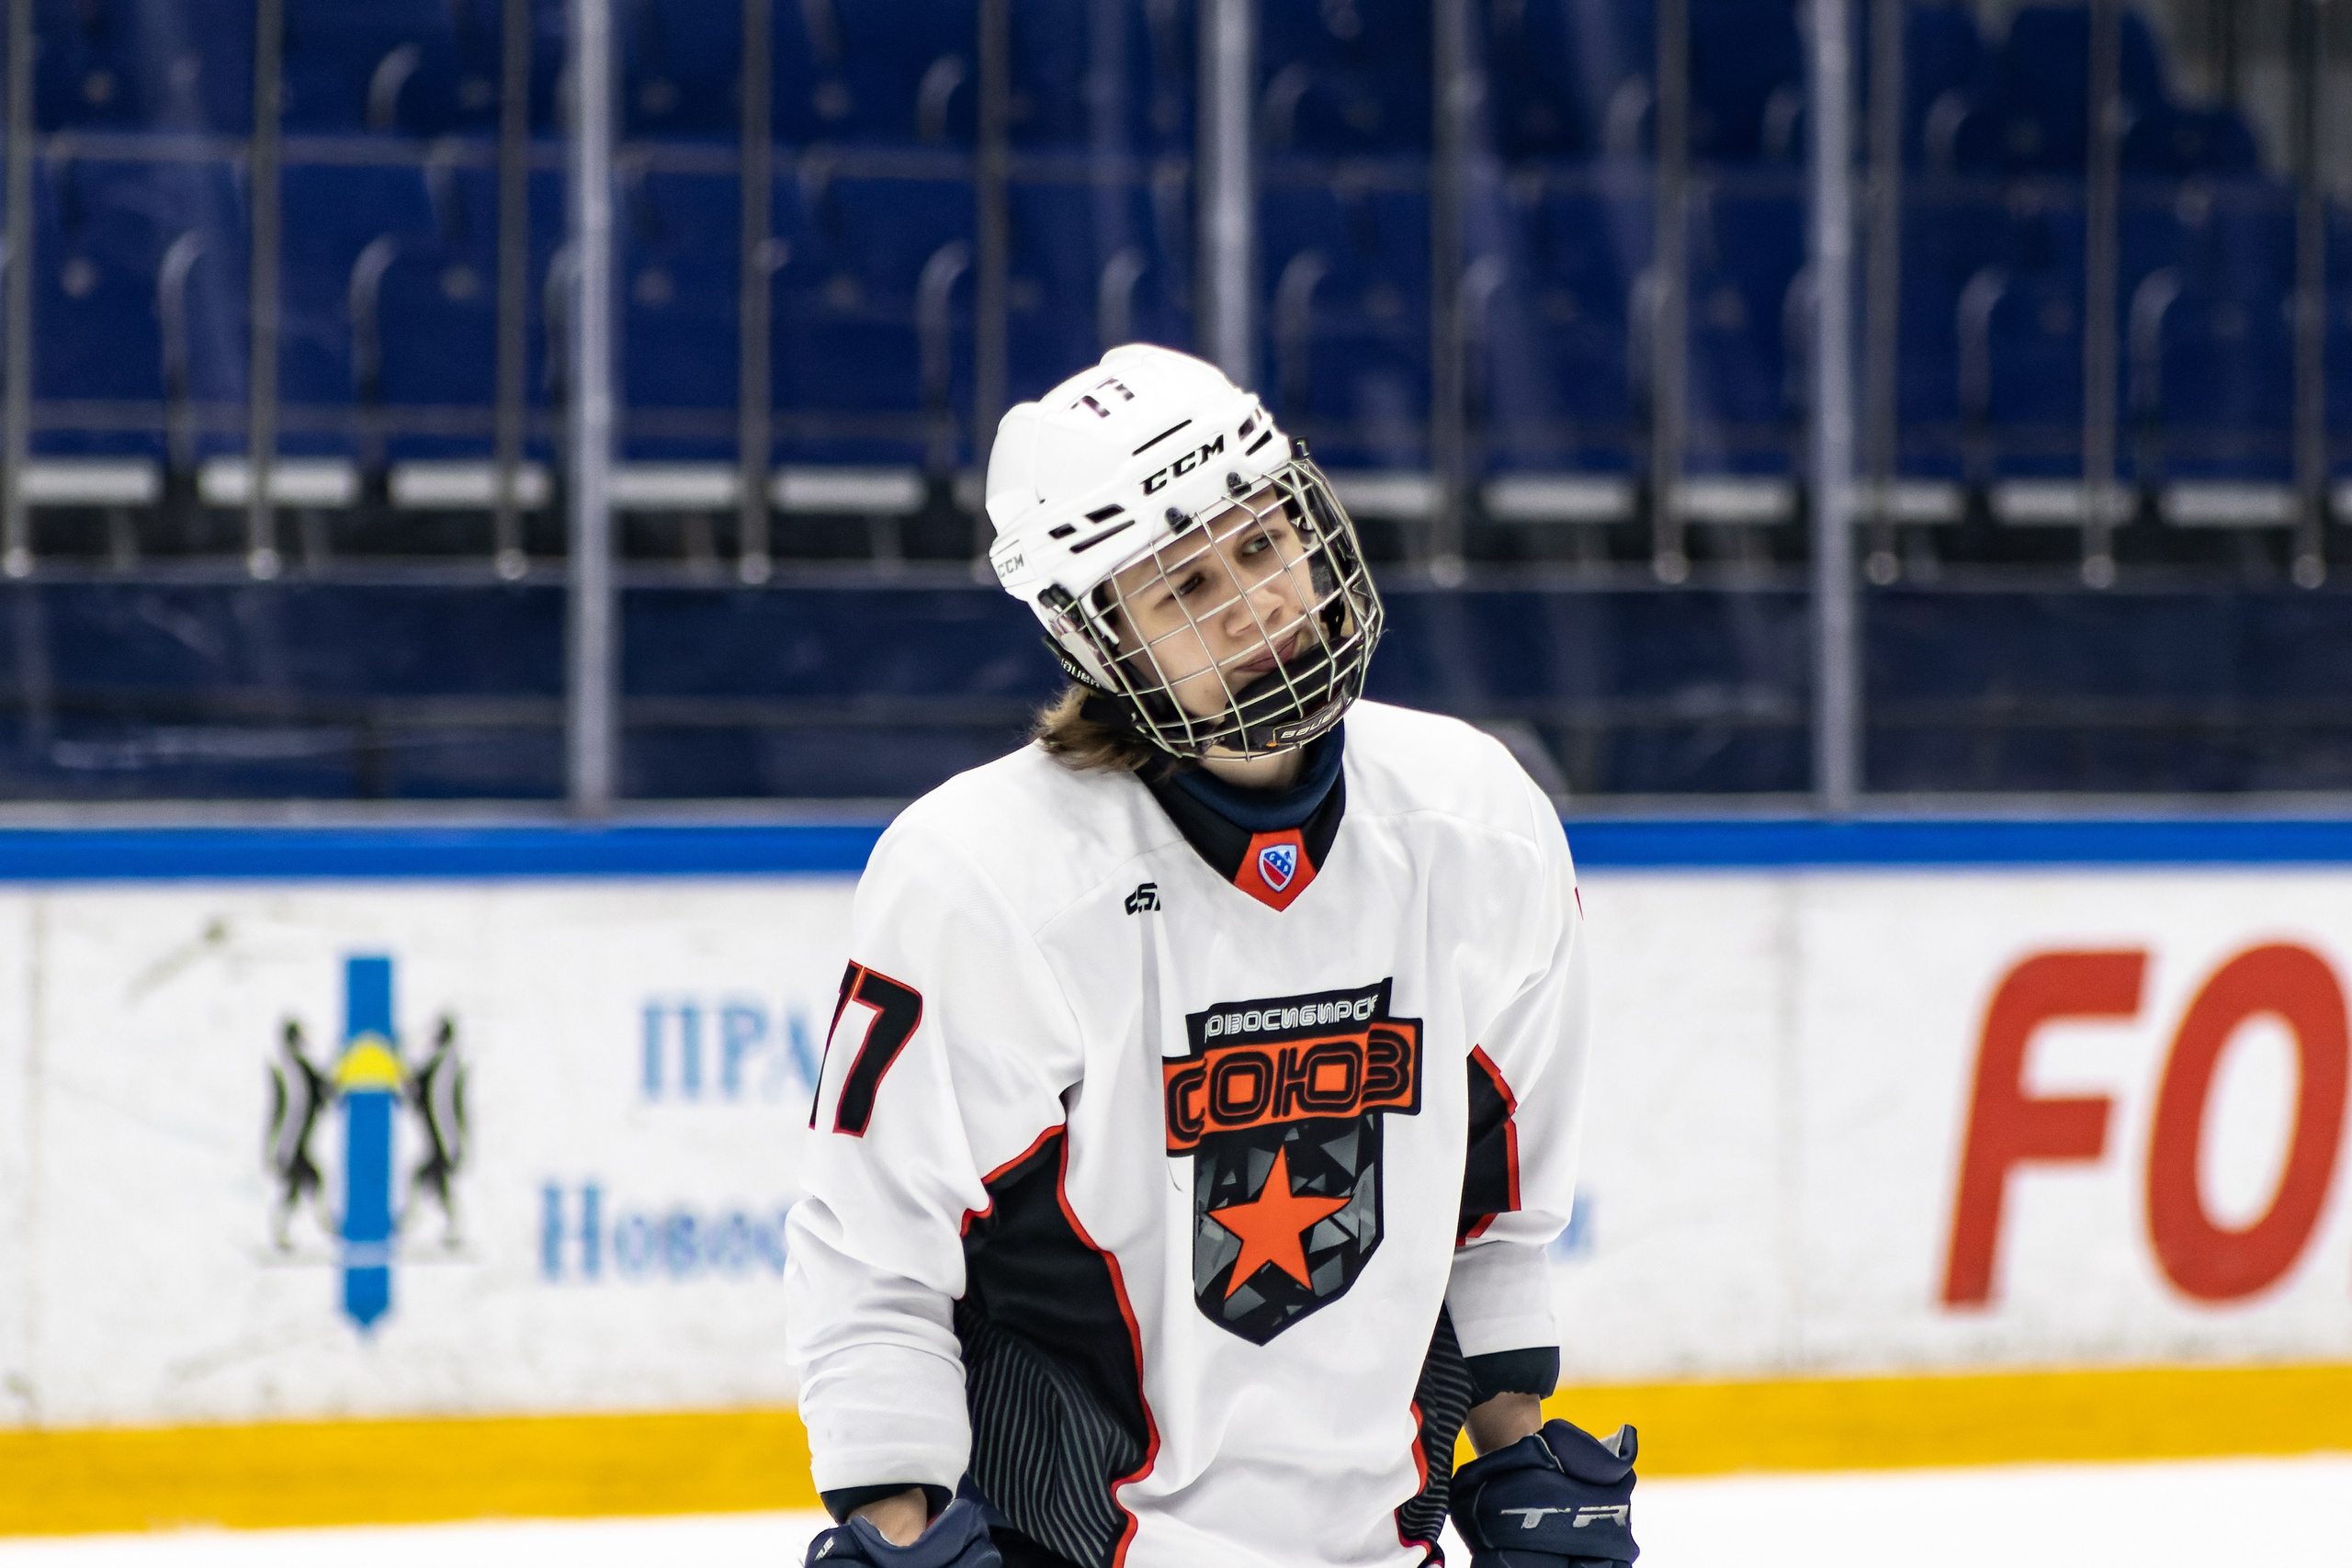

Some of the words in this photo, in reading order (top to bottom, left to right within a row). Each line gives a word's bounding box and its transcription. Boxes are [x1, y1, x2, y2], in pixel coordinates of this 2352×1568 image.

[1139, 434, 1225, 495] CCM
[997, 553, 1024, 579] CCM
[808, 958, 922, 1138] 7
[1204, 994, 1378, 1043] ОВОСИБИРСК
[1168, 1028, 1411, 1143] СОЮЗ
[1937, 943, 2352, 1310] FO
